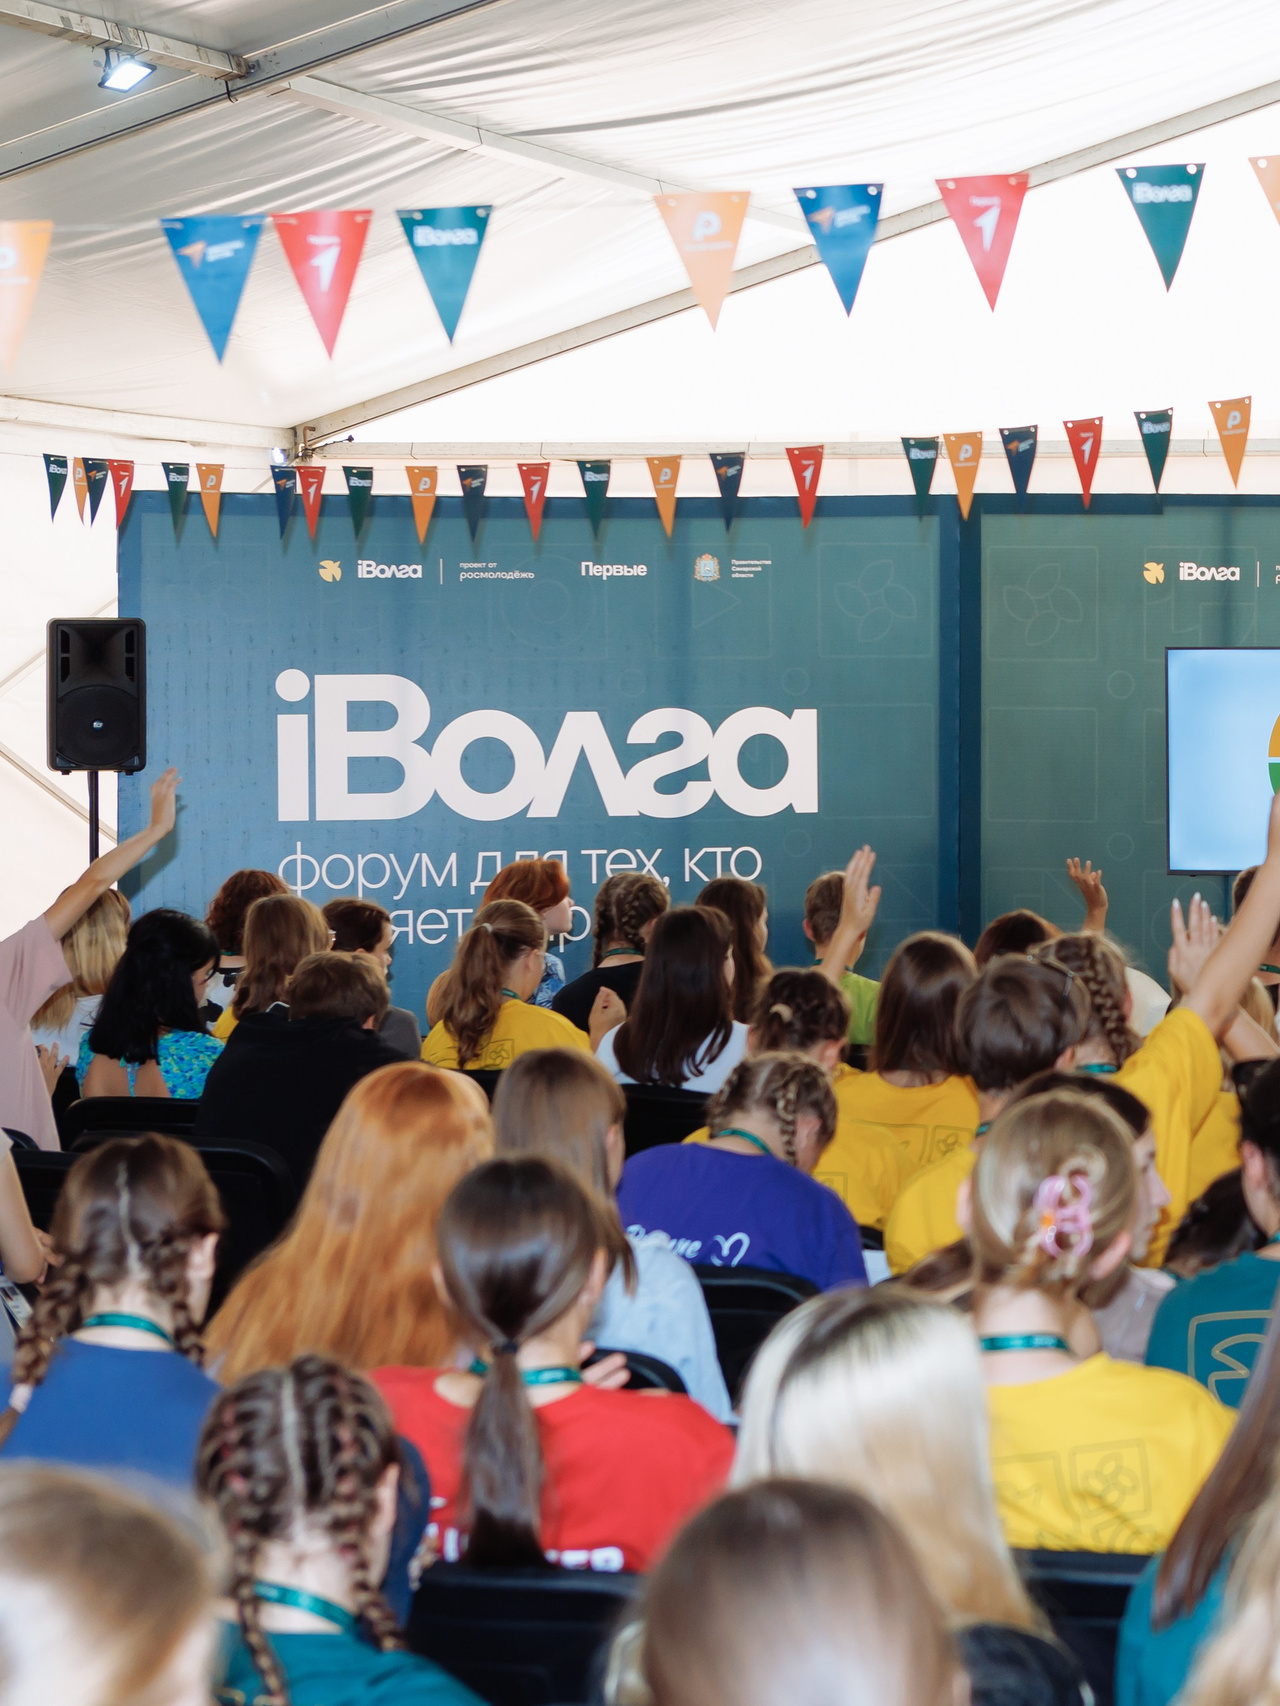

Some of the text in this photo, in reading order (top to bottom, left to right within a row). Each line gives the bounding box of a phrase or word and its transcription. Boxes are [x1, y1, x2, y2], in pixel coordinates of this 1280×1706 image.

[357, 559, 423, 579] iВолга
[459, 570, 535, 582] росмолодёжь
[581, 561, 647, 581] Первые
[1179, 562, 1240, 581] iВолга
[275, 669, 818, 822] iВолга
[278, 841, 457, 900] форум
[581, 848, 670, 887] тех,
[684, 846, 762, 882] кто
